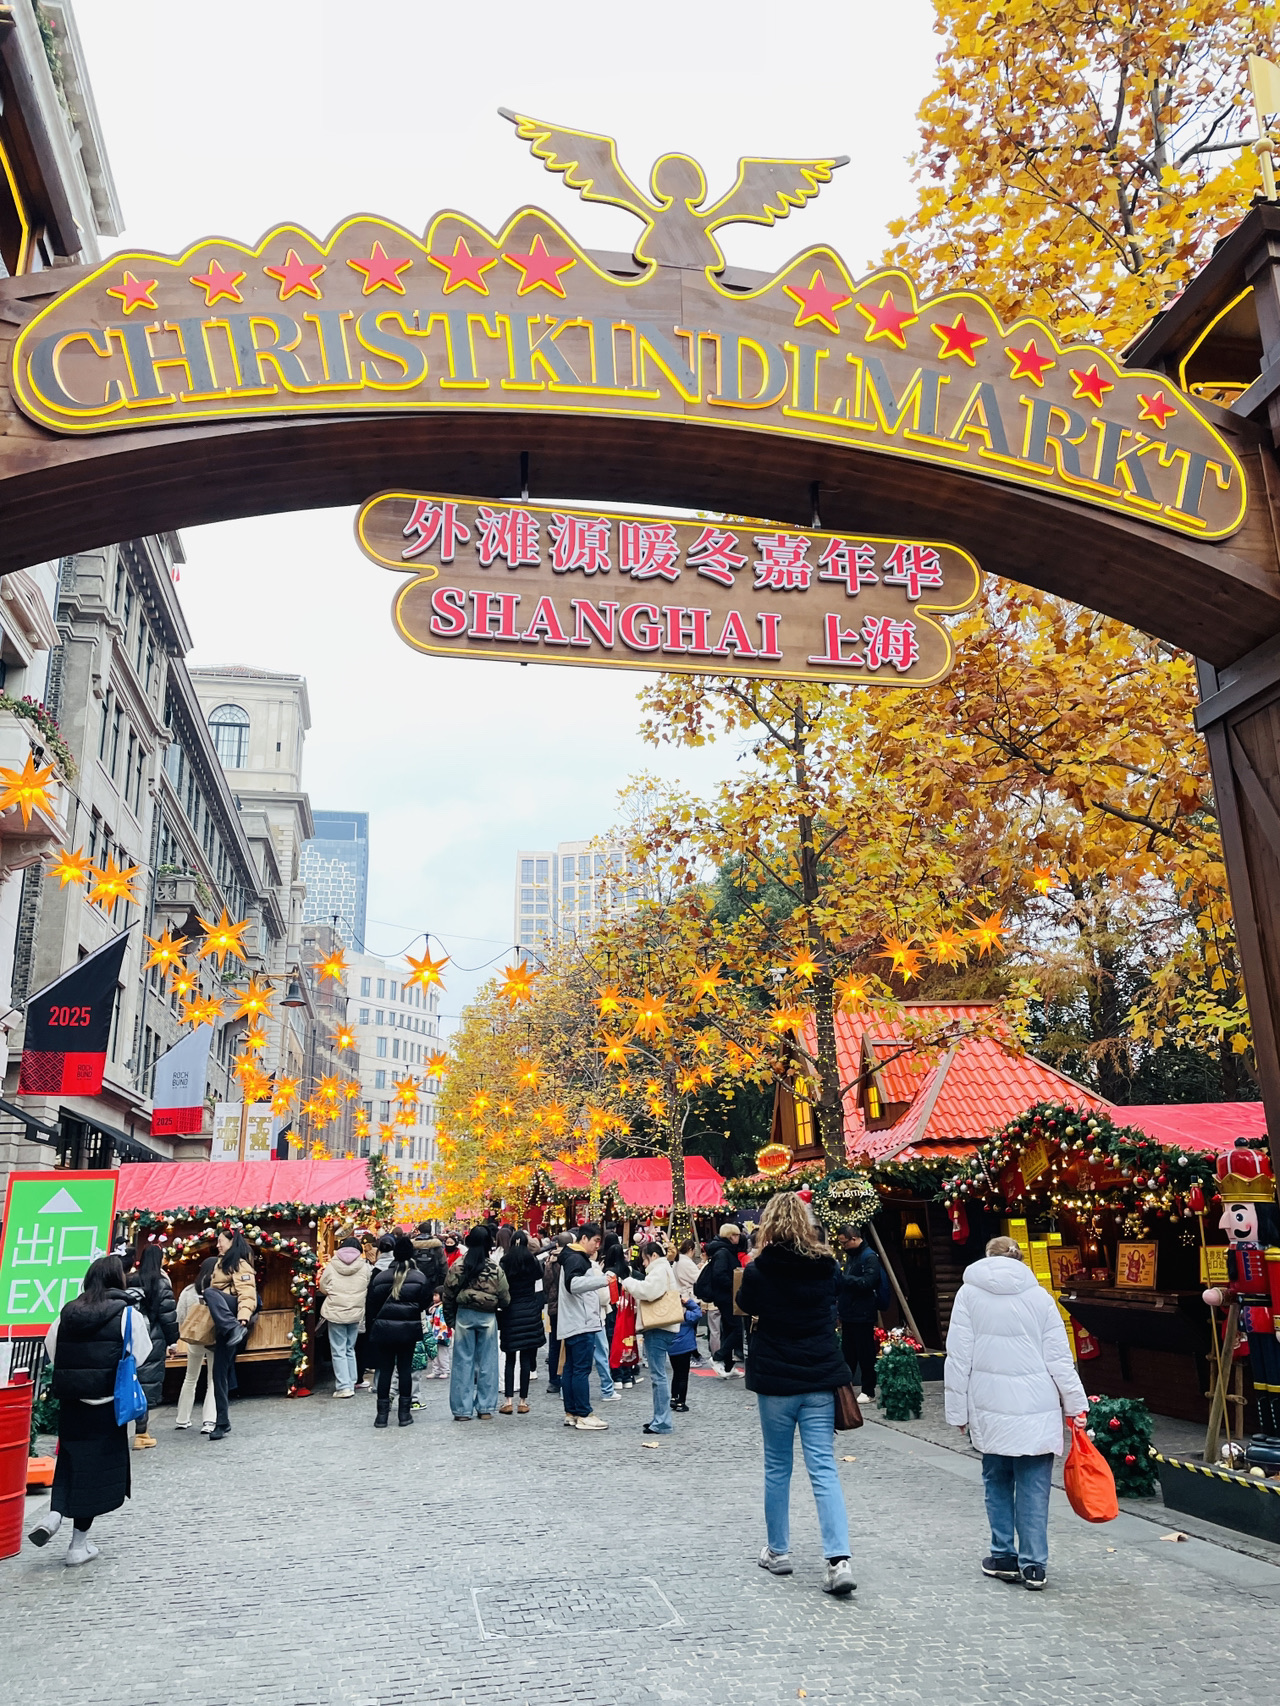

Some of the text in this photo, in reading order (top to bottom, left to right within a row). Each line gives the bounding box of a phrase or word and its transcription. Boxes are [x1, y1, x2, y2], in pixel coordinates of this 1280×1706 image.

[27, 309, 1233, 529] CHRISTKINDLMARKT
[402, 497, 944, 600] 外滩源暖冬嘉年华
[429, 585, 919, 672] SHANGHAI 上海
[48, 1005, 91, 1027] 2025
[171, 1078, 188, 1087] BUND
[156, 1117, 173, 1126] 2025
[11, 1223, 98, 1267] 出口
